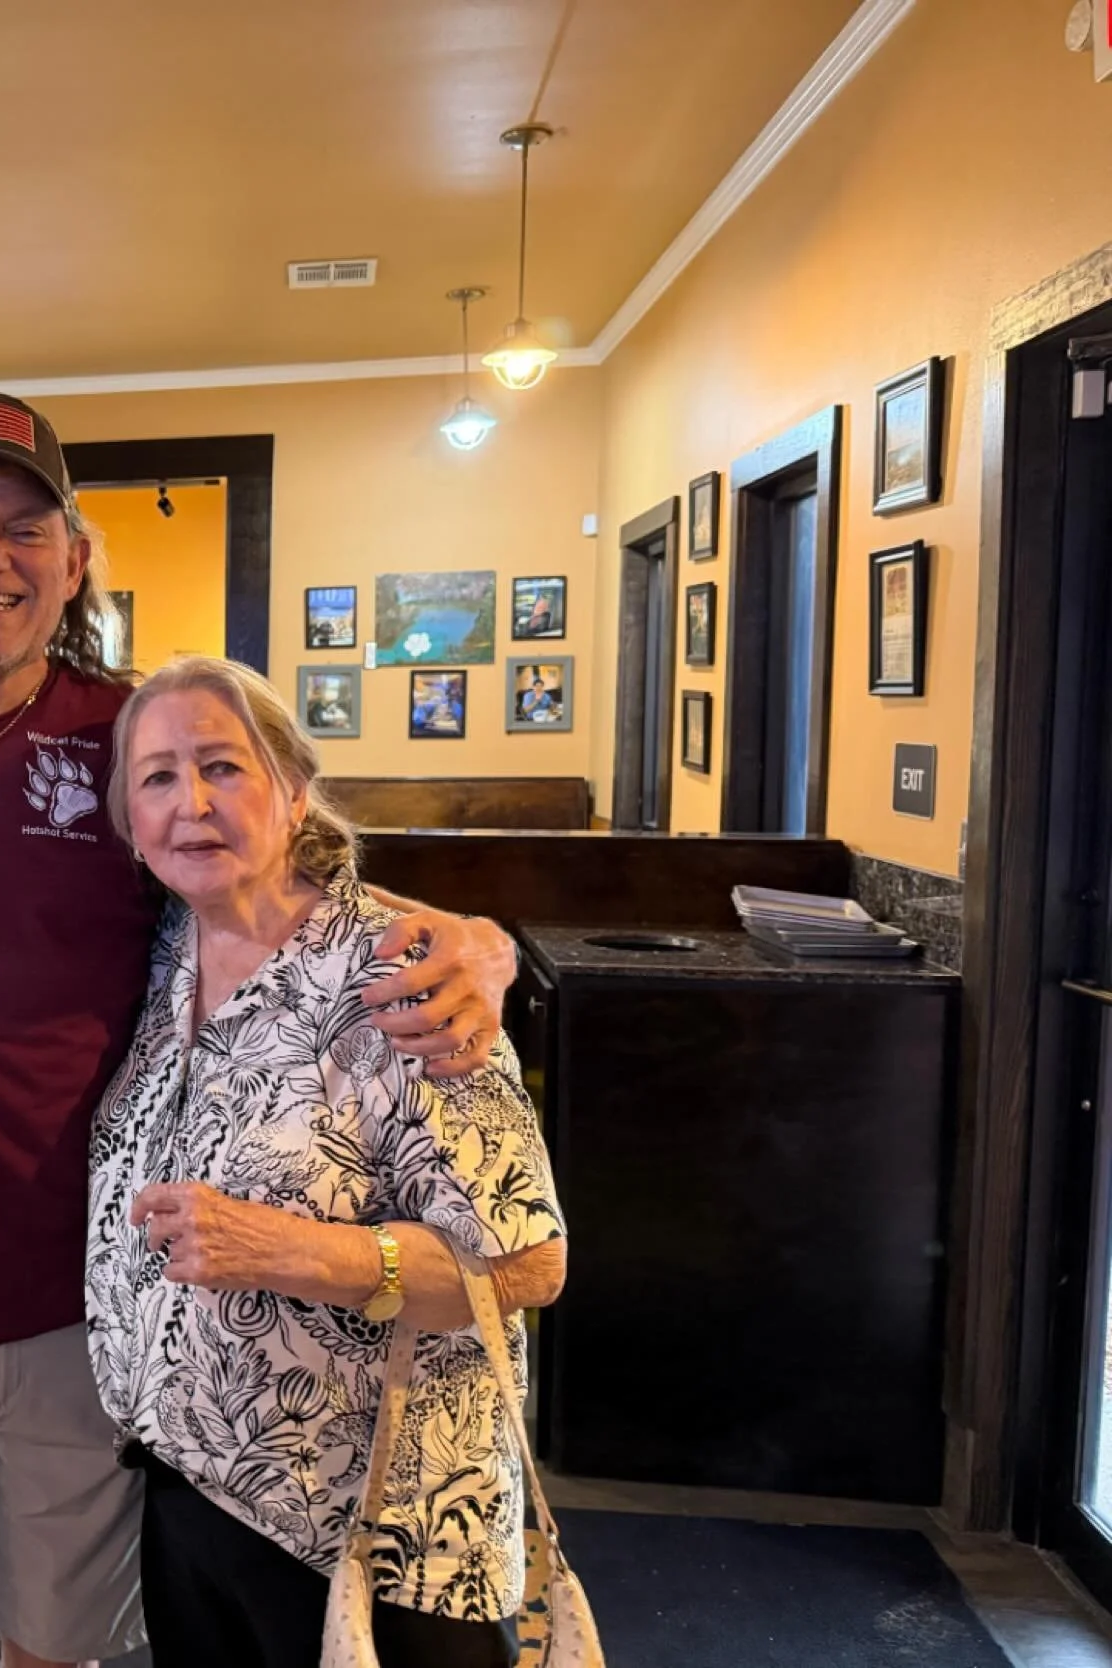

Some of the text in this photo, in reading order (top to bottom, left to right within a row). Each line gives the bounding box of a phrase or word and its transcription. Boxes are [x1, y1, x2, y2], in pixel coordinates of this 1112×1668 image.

[27, 731, 100, 749] Wildcat Pride
[901, 768, 924, 792] EXIT
[22, 825, 98, 842] Hotshot Service
